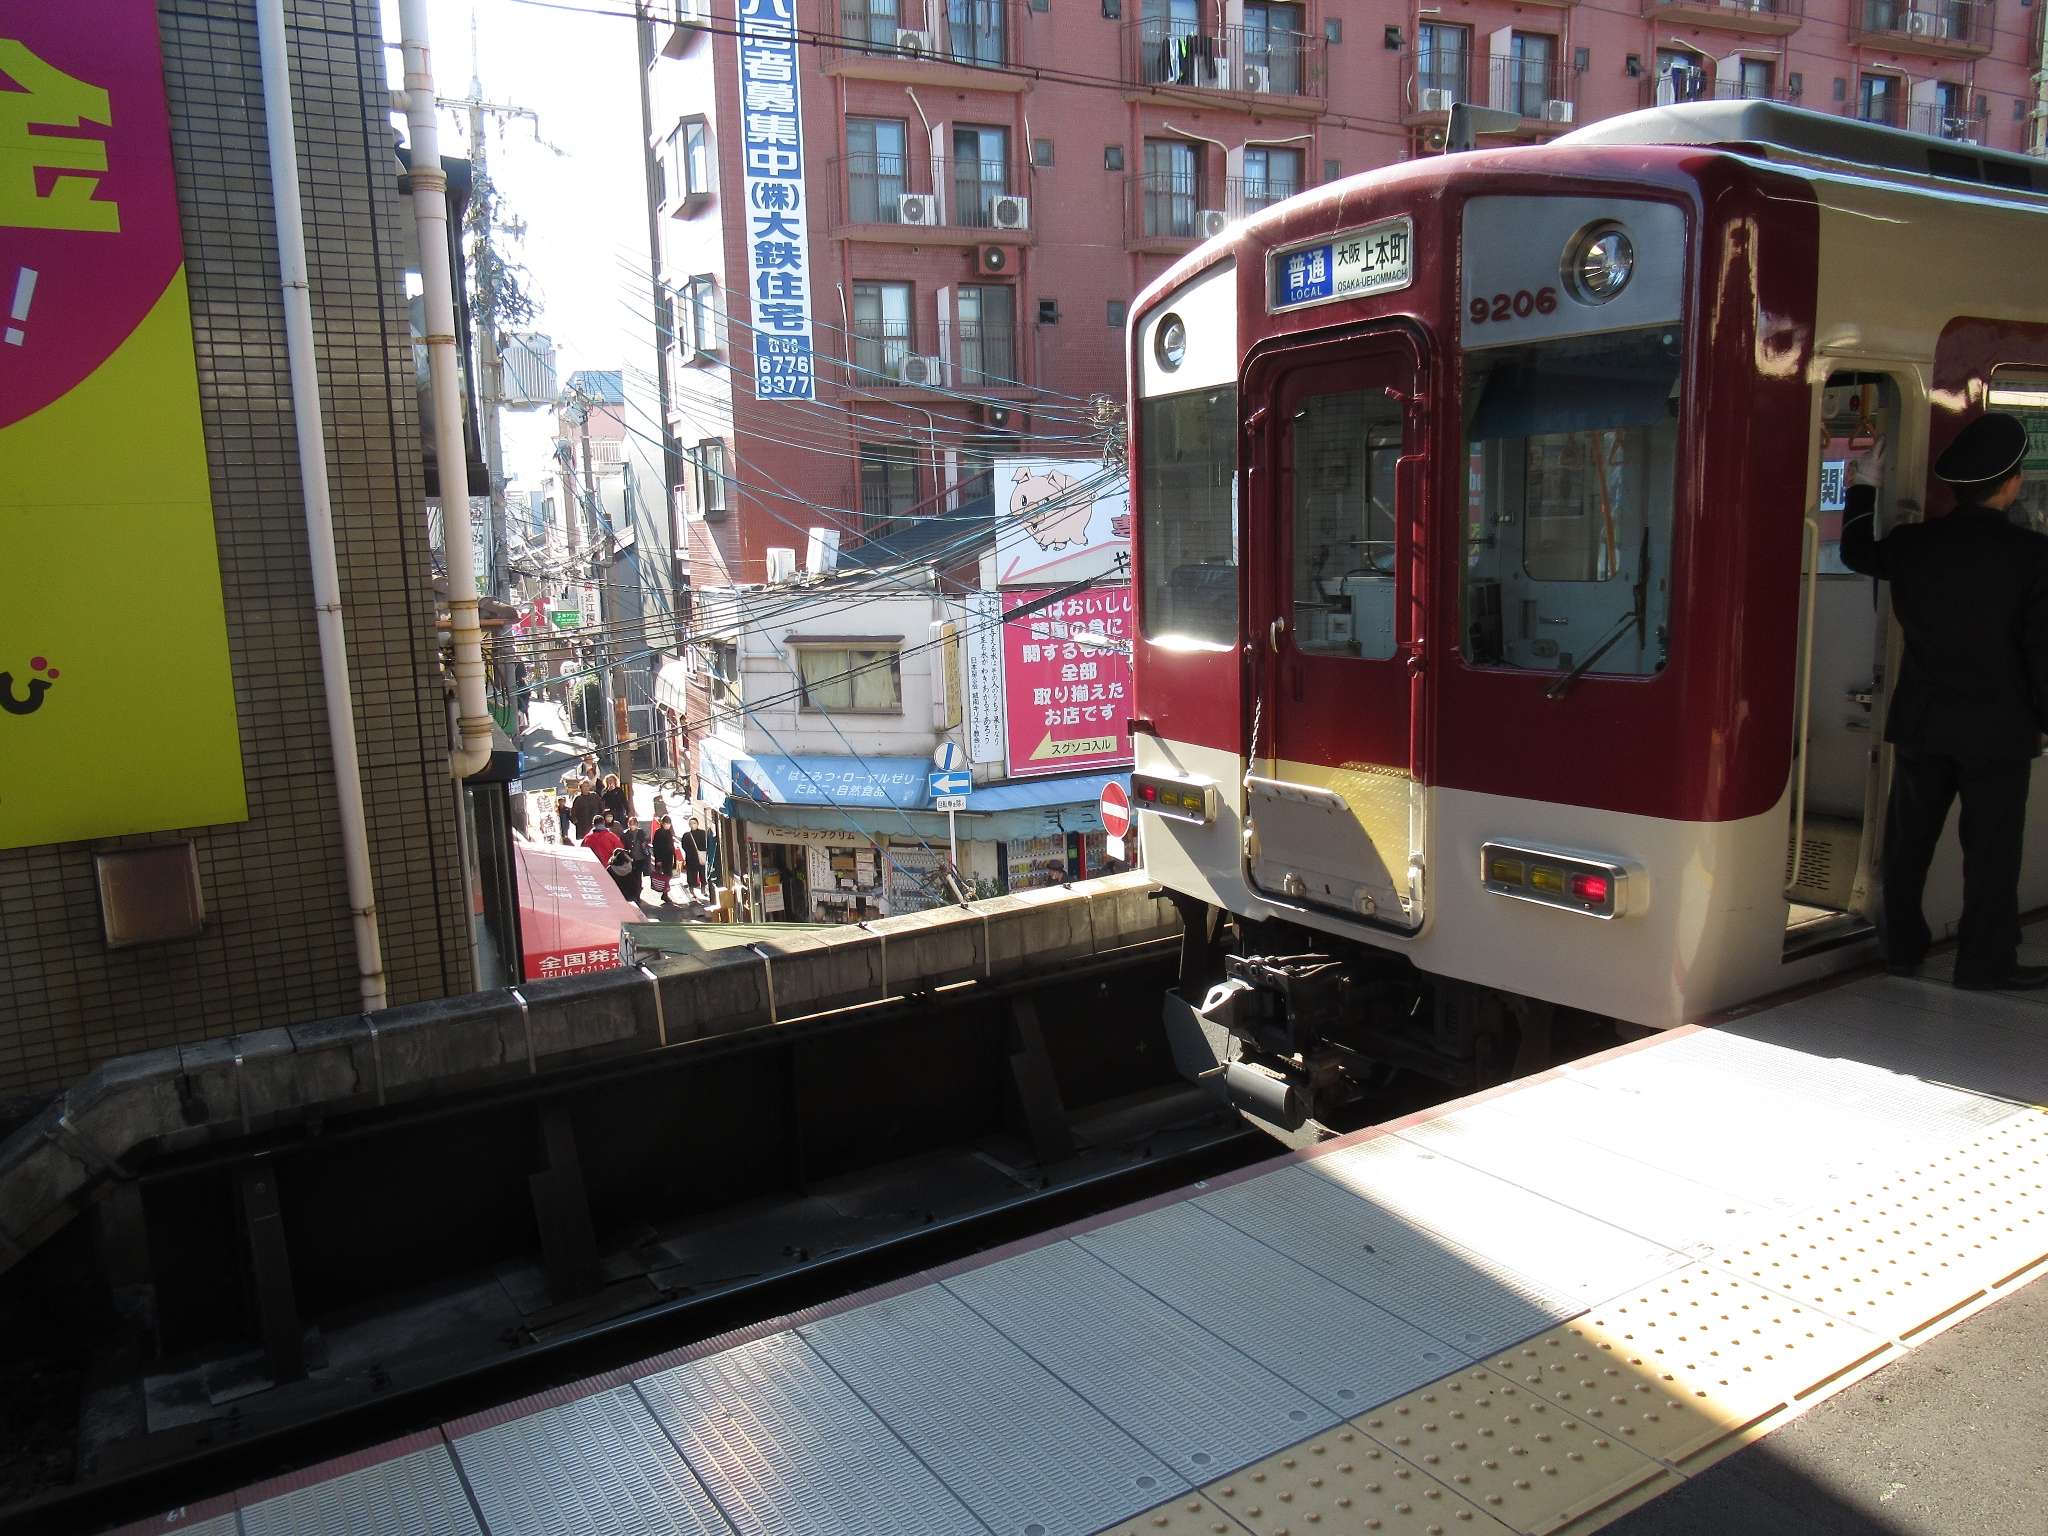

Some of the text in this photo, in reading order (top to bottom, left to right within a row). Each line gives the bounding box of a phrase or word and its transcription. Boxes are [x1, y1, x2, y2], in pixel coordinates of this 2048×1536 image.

[1338, 233, 1408, 273] 大阪上本町
[1288, 250, 1326, 289] 普通
[1337, 268, 1408, 292] OSAKA-UEHOMMACH
[1290, 288, 1323, 301] LOCAL
[1470, 286, 1557, 325] 9206
[759, 356, 809, 373] 6776
[760, 376, 810, 394] 3377
[1061, 662, 1097, 682] 全部
[1033, 682, 1124, 706] 取り揃えた
[1045, 703, 1116, 726] お店です
[1051, 738, 1111, 755] スグソコ入ル
